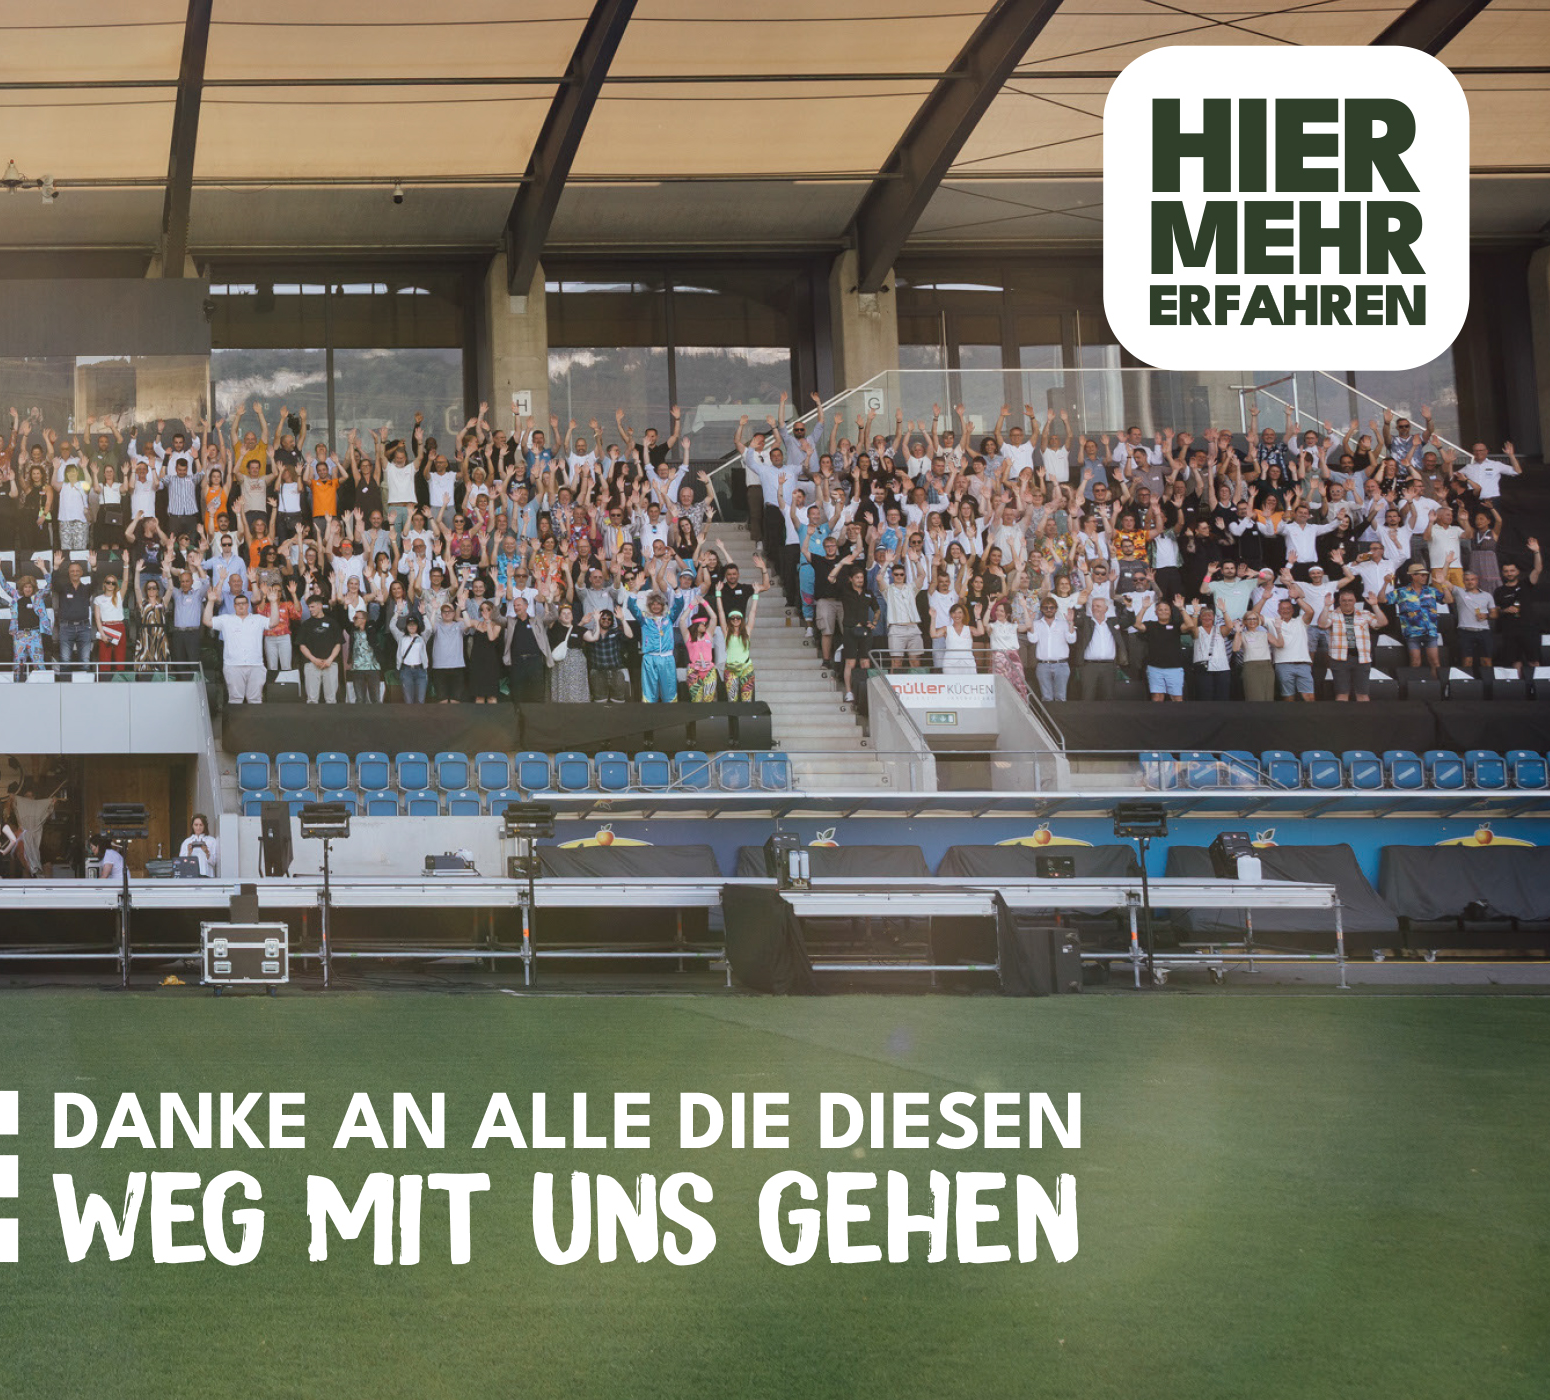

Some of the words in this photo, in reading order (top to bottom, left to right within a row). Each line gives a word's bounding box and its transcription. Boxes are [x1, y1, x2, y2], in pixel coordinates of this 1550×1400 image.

[516, 399, 528, 412] H
[867, 397, 881, 411] G
[947, 682, 993, 694] KÜCHEN
